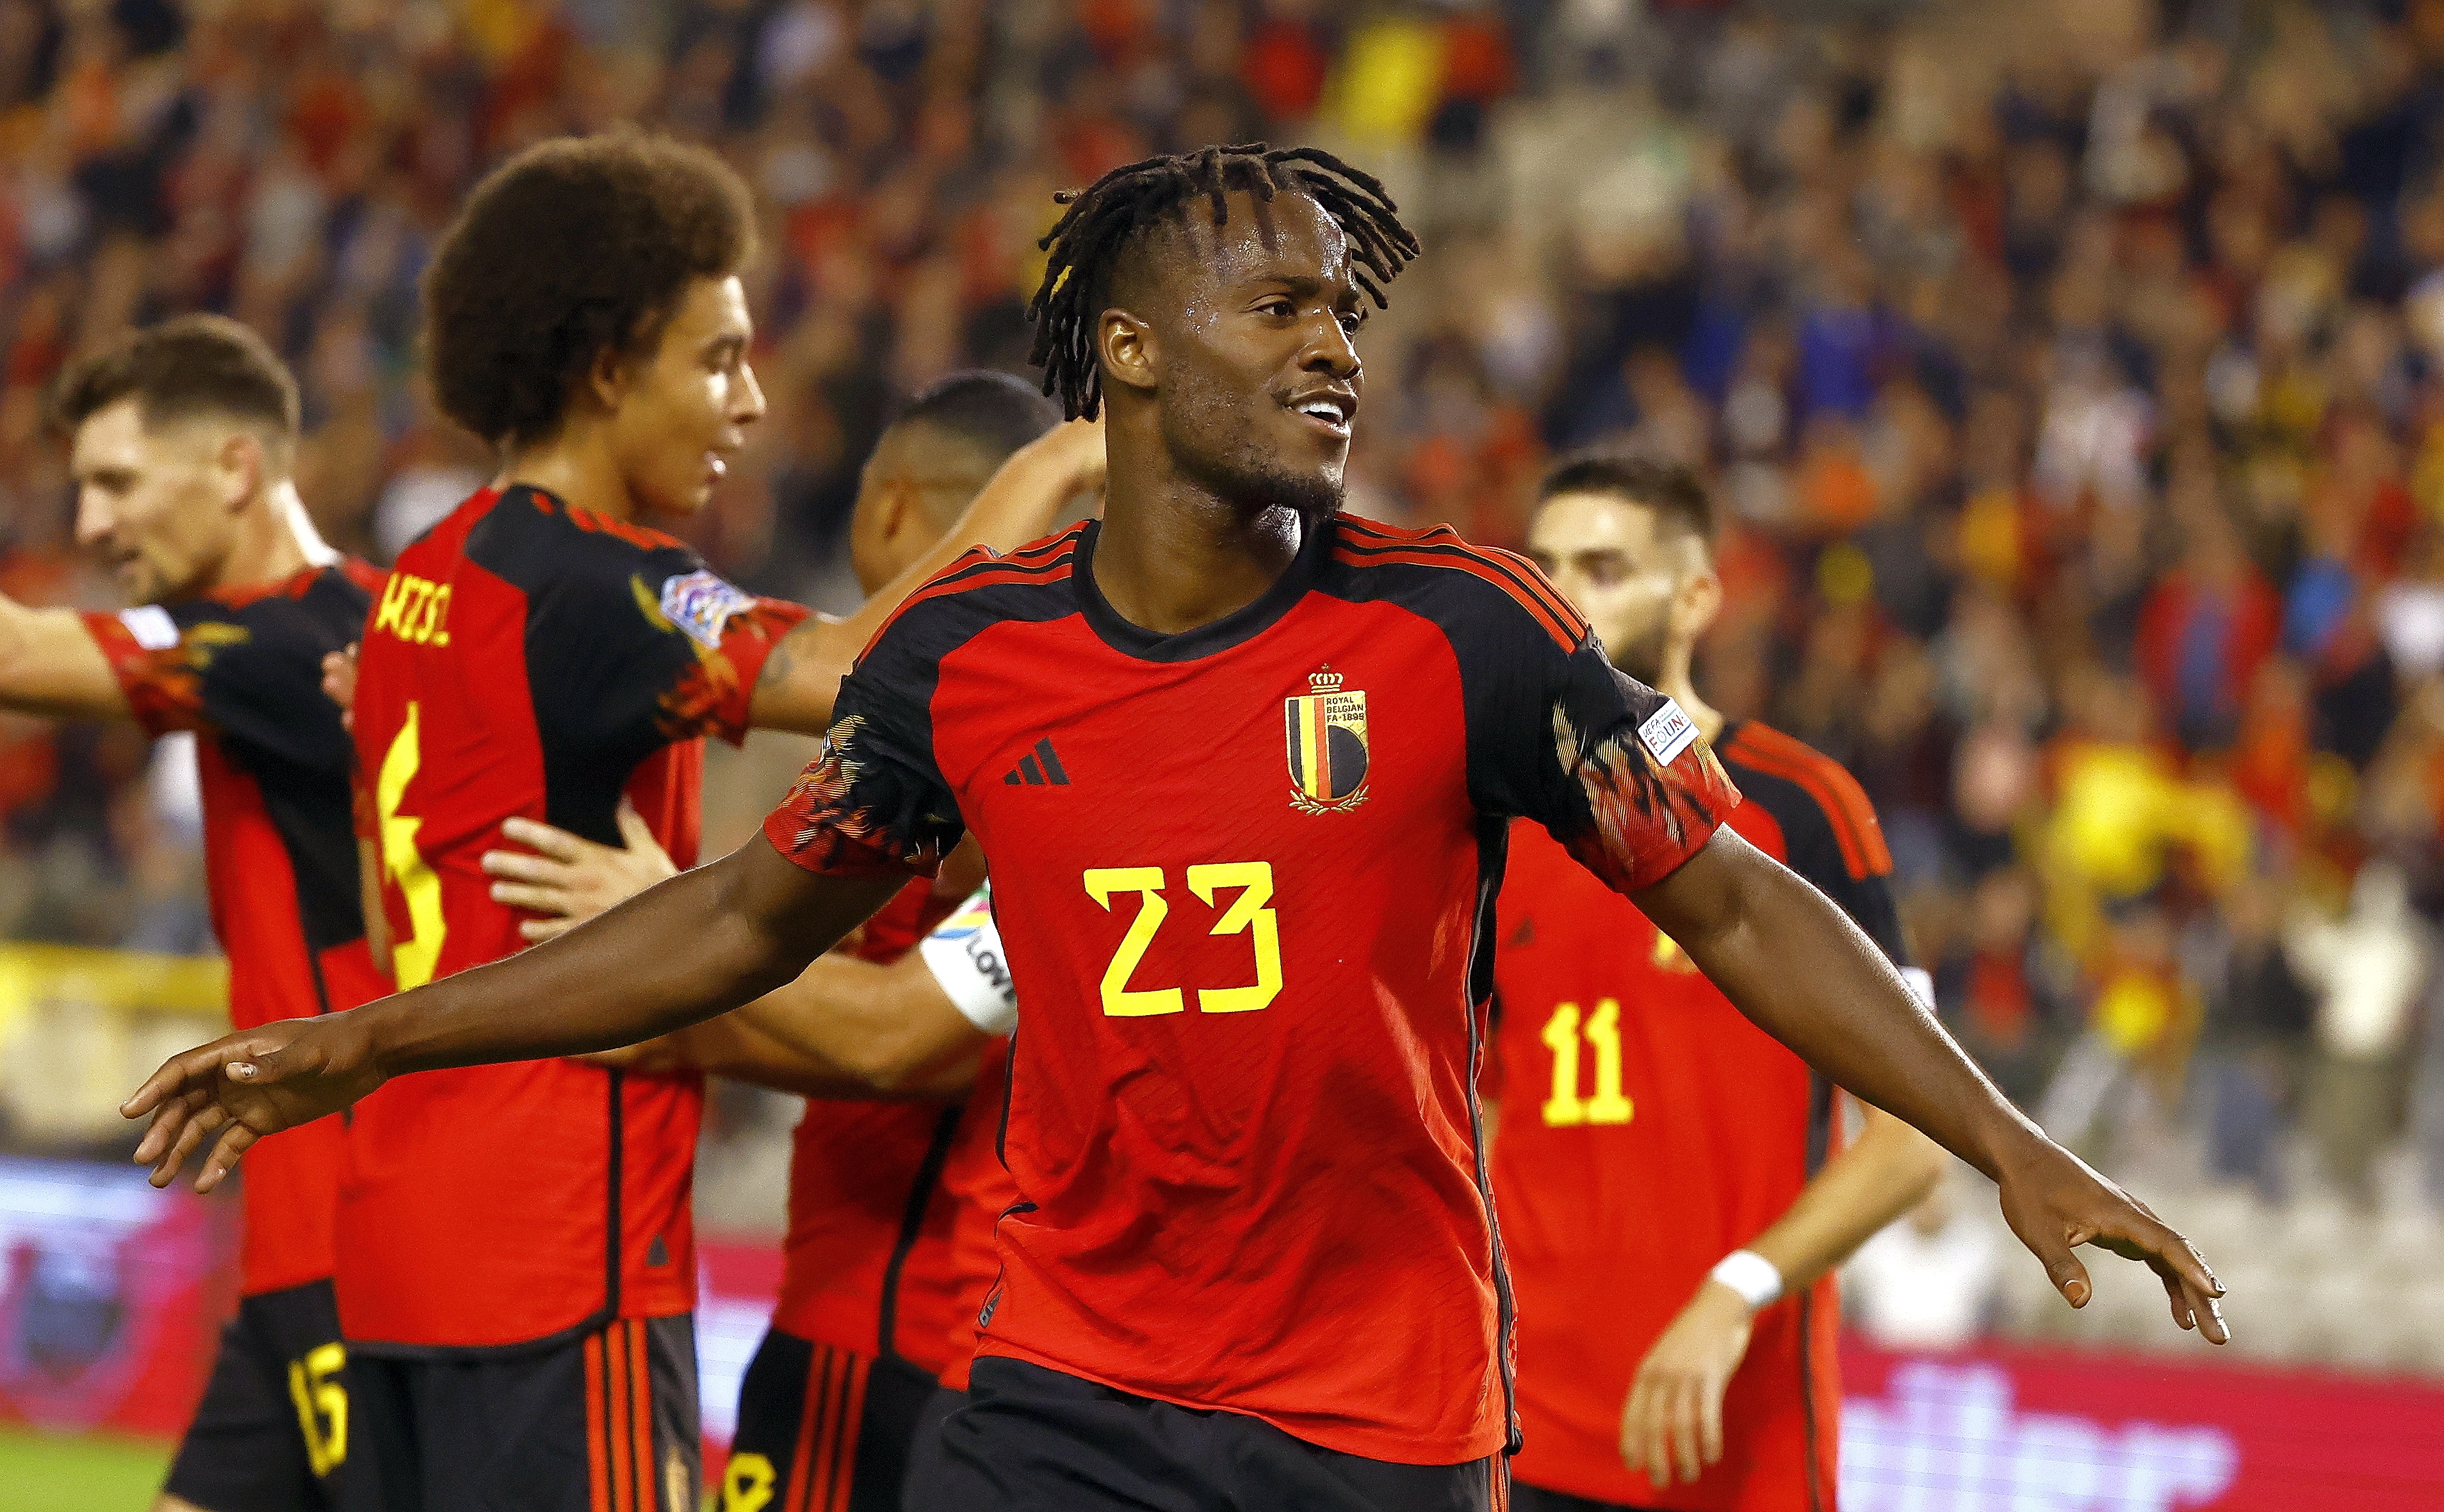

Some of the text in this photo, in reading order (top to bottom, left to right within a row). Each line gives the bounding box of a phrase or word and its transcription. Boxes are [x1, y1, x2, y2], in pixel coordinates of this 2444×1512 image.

[1326, 696, 1354, 705] ROYAL
[1326, 704, 1364, 713] BELGIAN
[1083, 861, 1283, 1017] 23
[1542, 998, 1634, 1127] 11
[288, 1341, 349, 1478] 15
